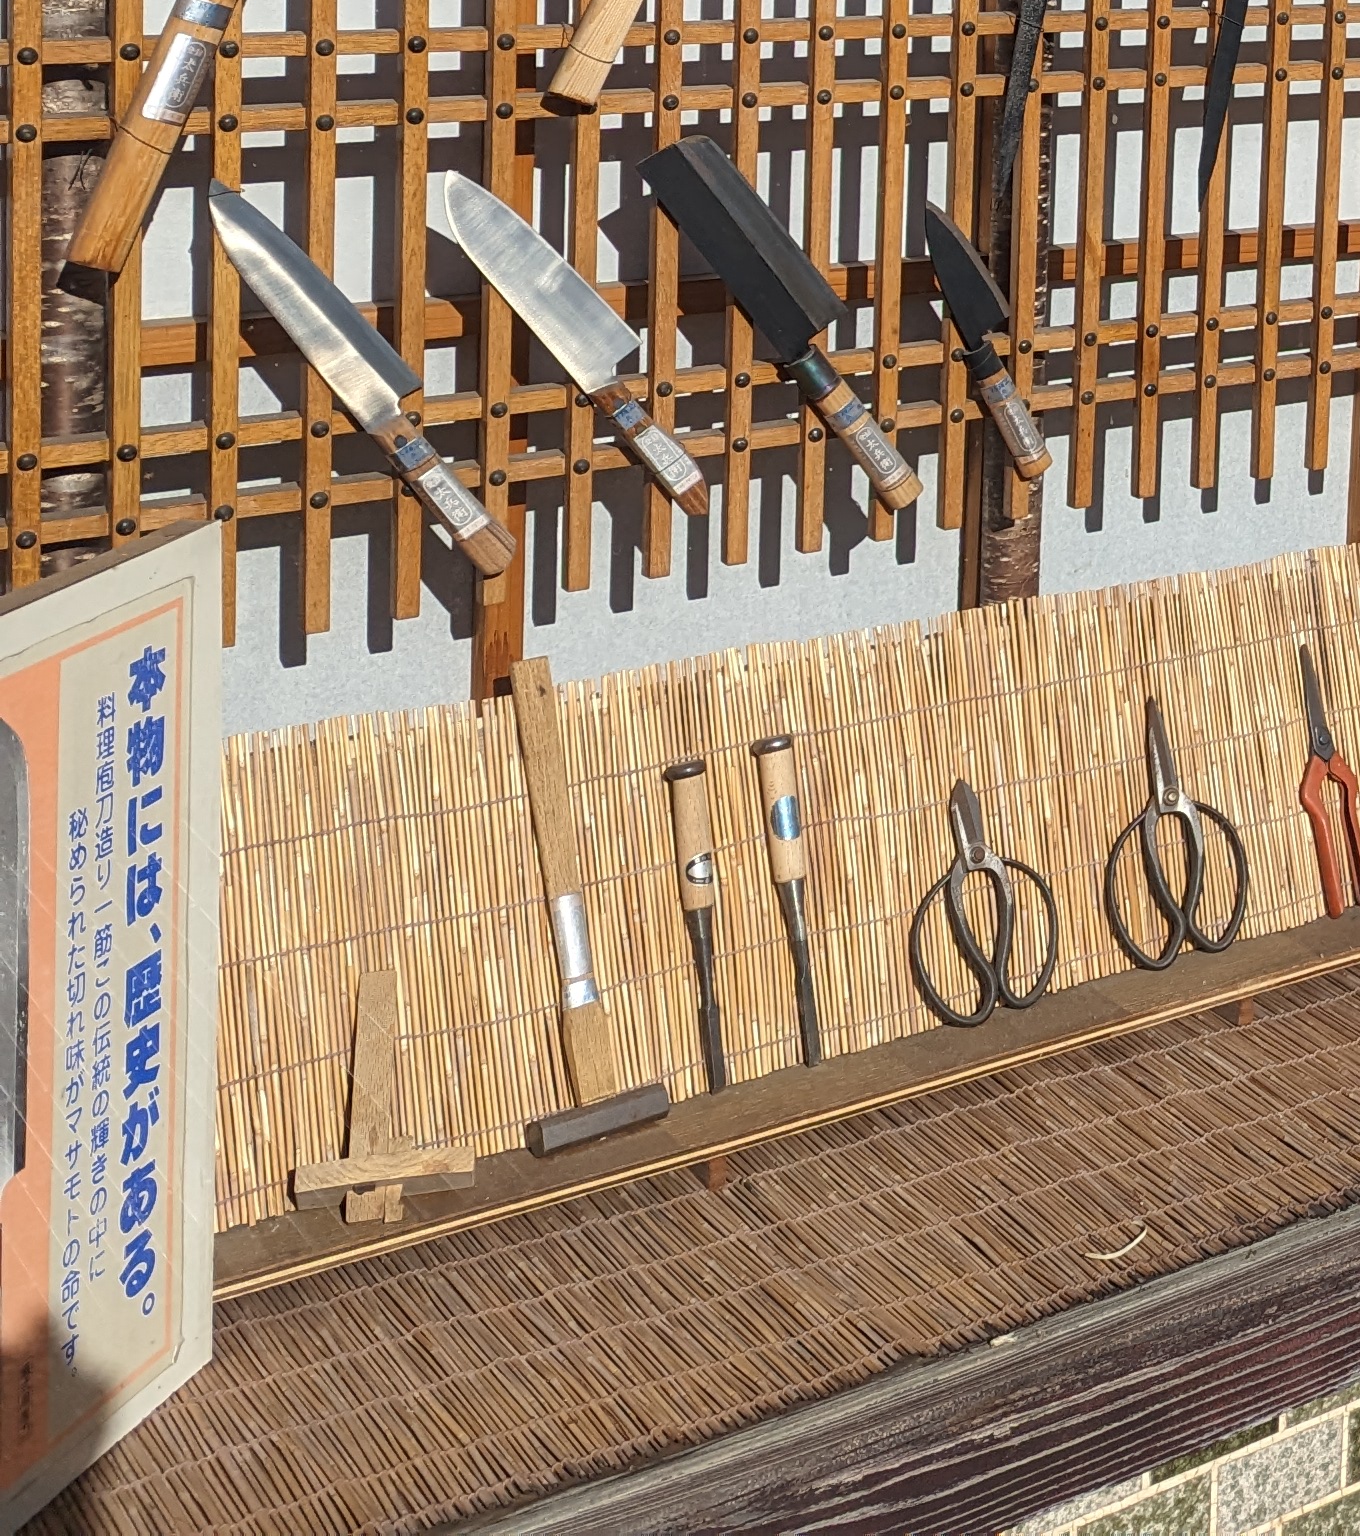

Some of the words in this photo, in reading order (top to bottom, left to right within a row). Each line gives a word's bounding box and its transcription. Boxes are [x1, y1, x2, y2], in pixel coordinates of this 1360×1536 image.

[60, 807, 89, 1378] 秘められた切れ味がマサモトの命です。
[87, 691, 117, 1282] 料理庖刀造り一筋この伝統の輝きの中に
[117, 644, 166, 1318] 本物には、歴史がある。
